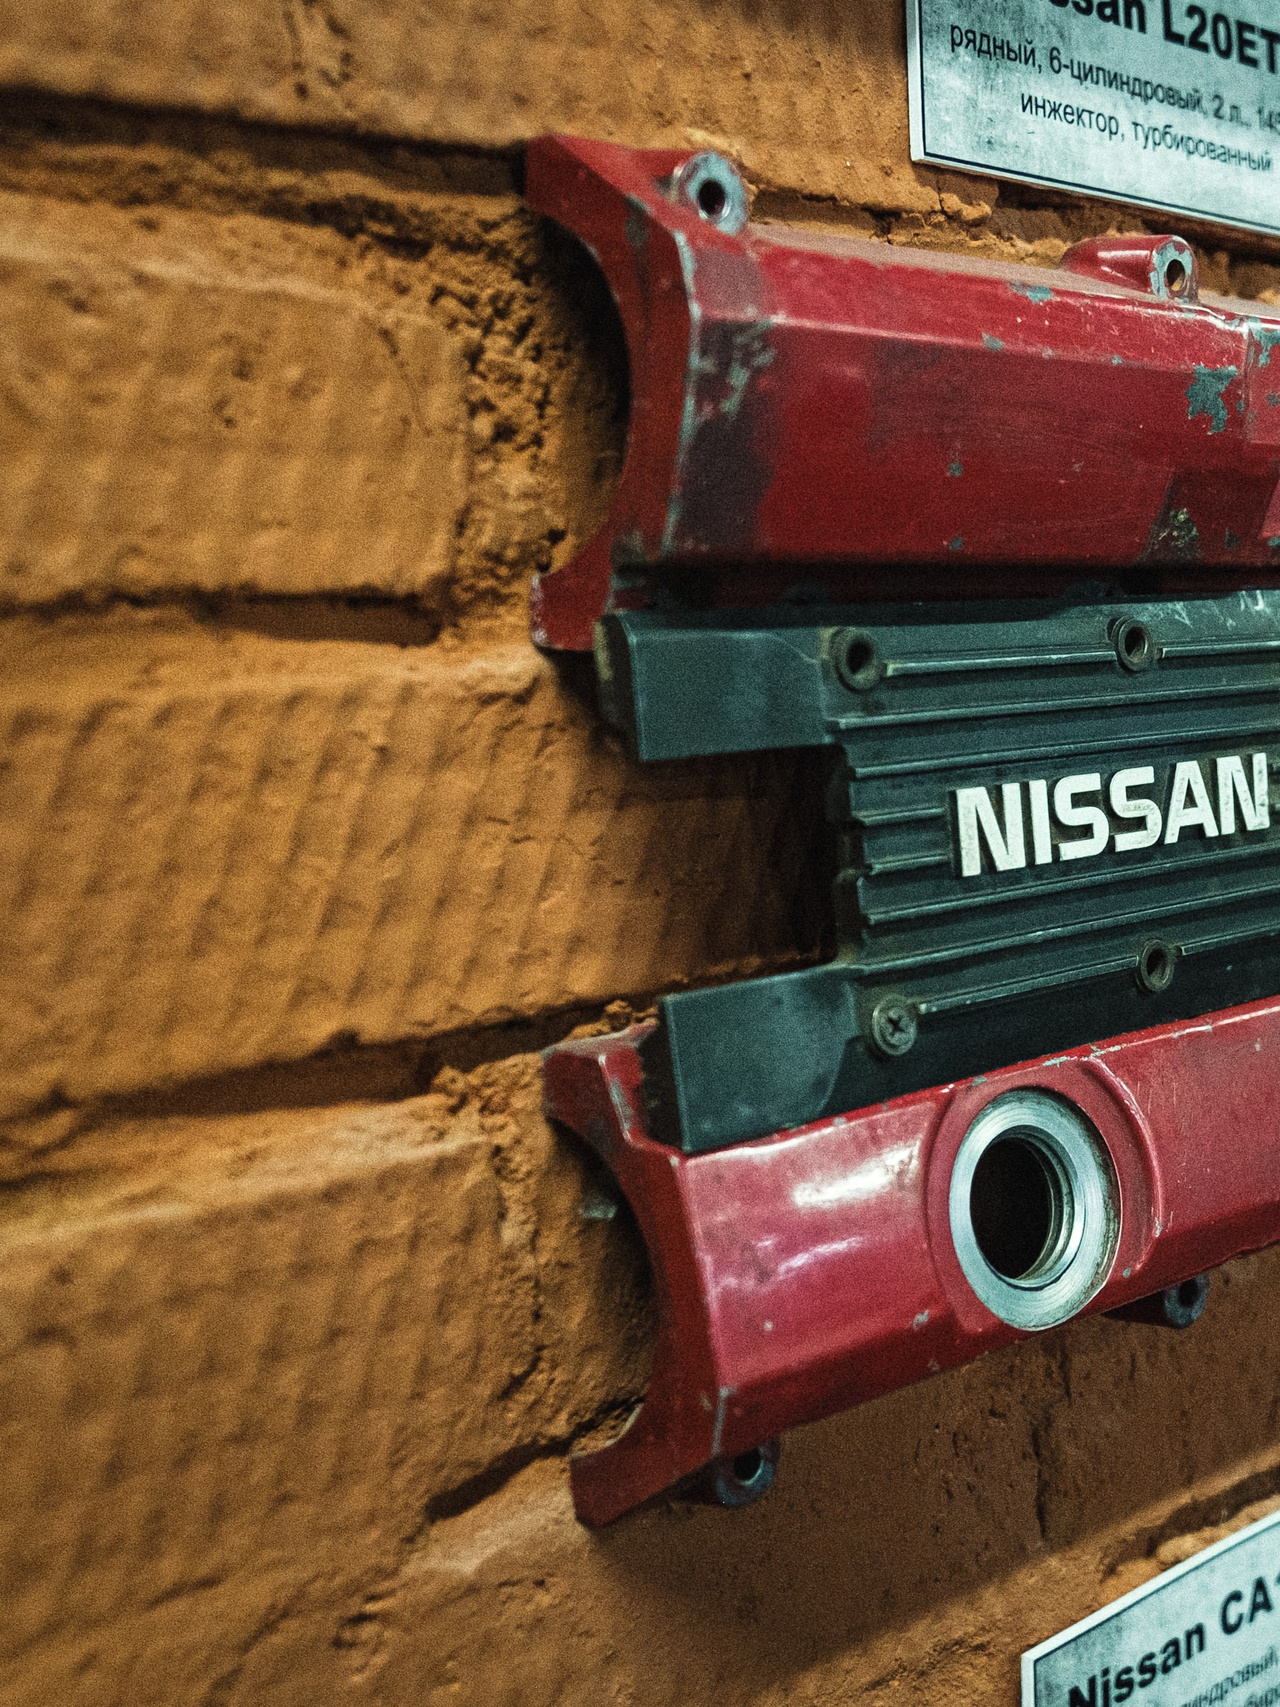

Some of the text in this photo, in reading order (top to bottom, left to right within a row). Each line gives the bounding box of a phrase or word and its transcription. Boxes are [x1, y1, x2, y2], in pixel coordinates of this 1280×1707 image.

[950, 24, 1042, 74] рядный,
[1211, 94, 1225, 120] 2
[1020, 93, 1274, 171] инжектор, турбированный
[953, 751, 1272, 877] NISSAN
